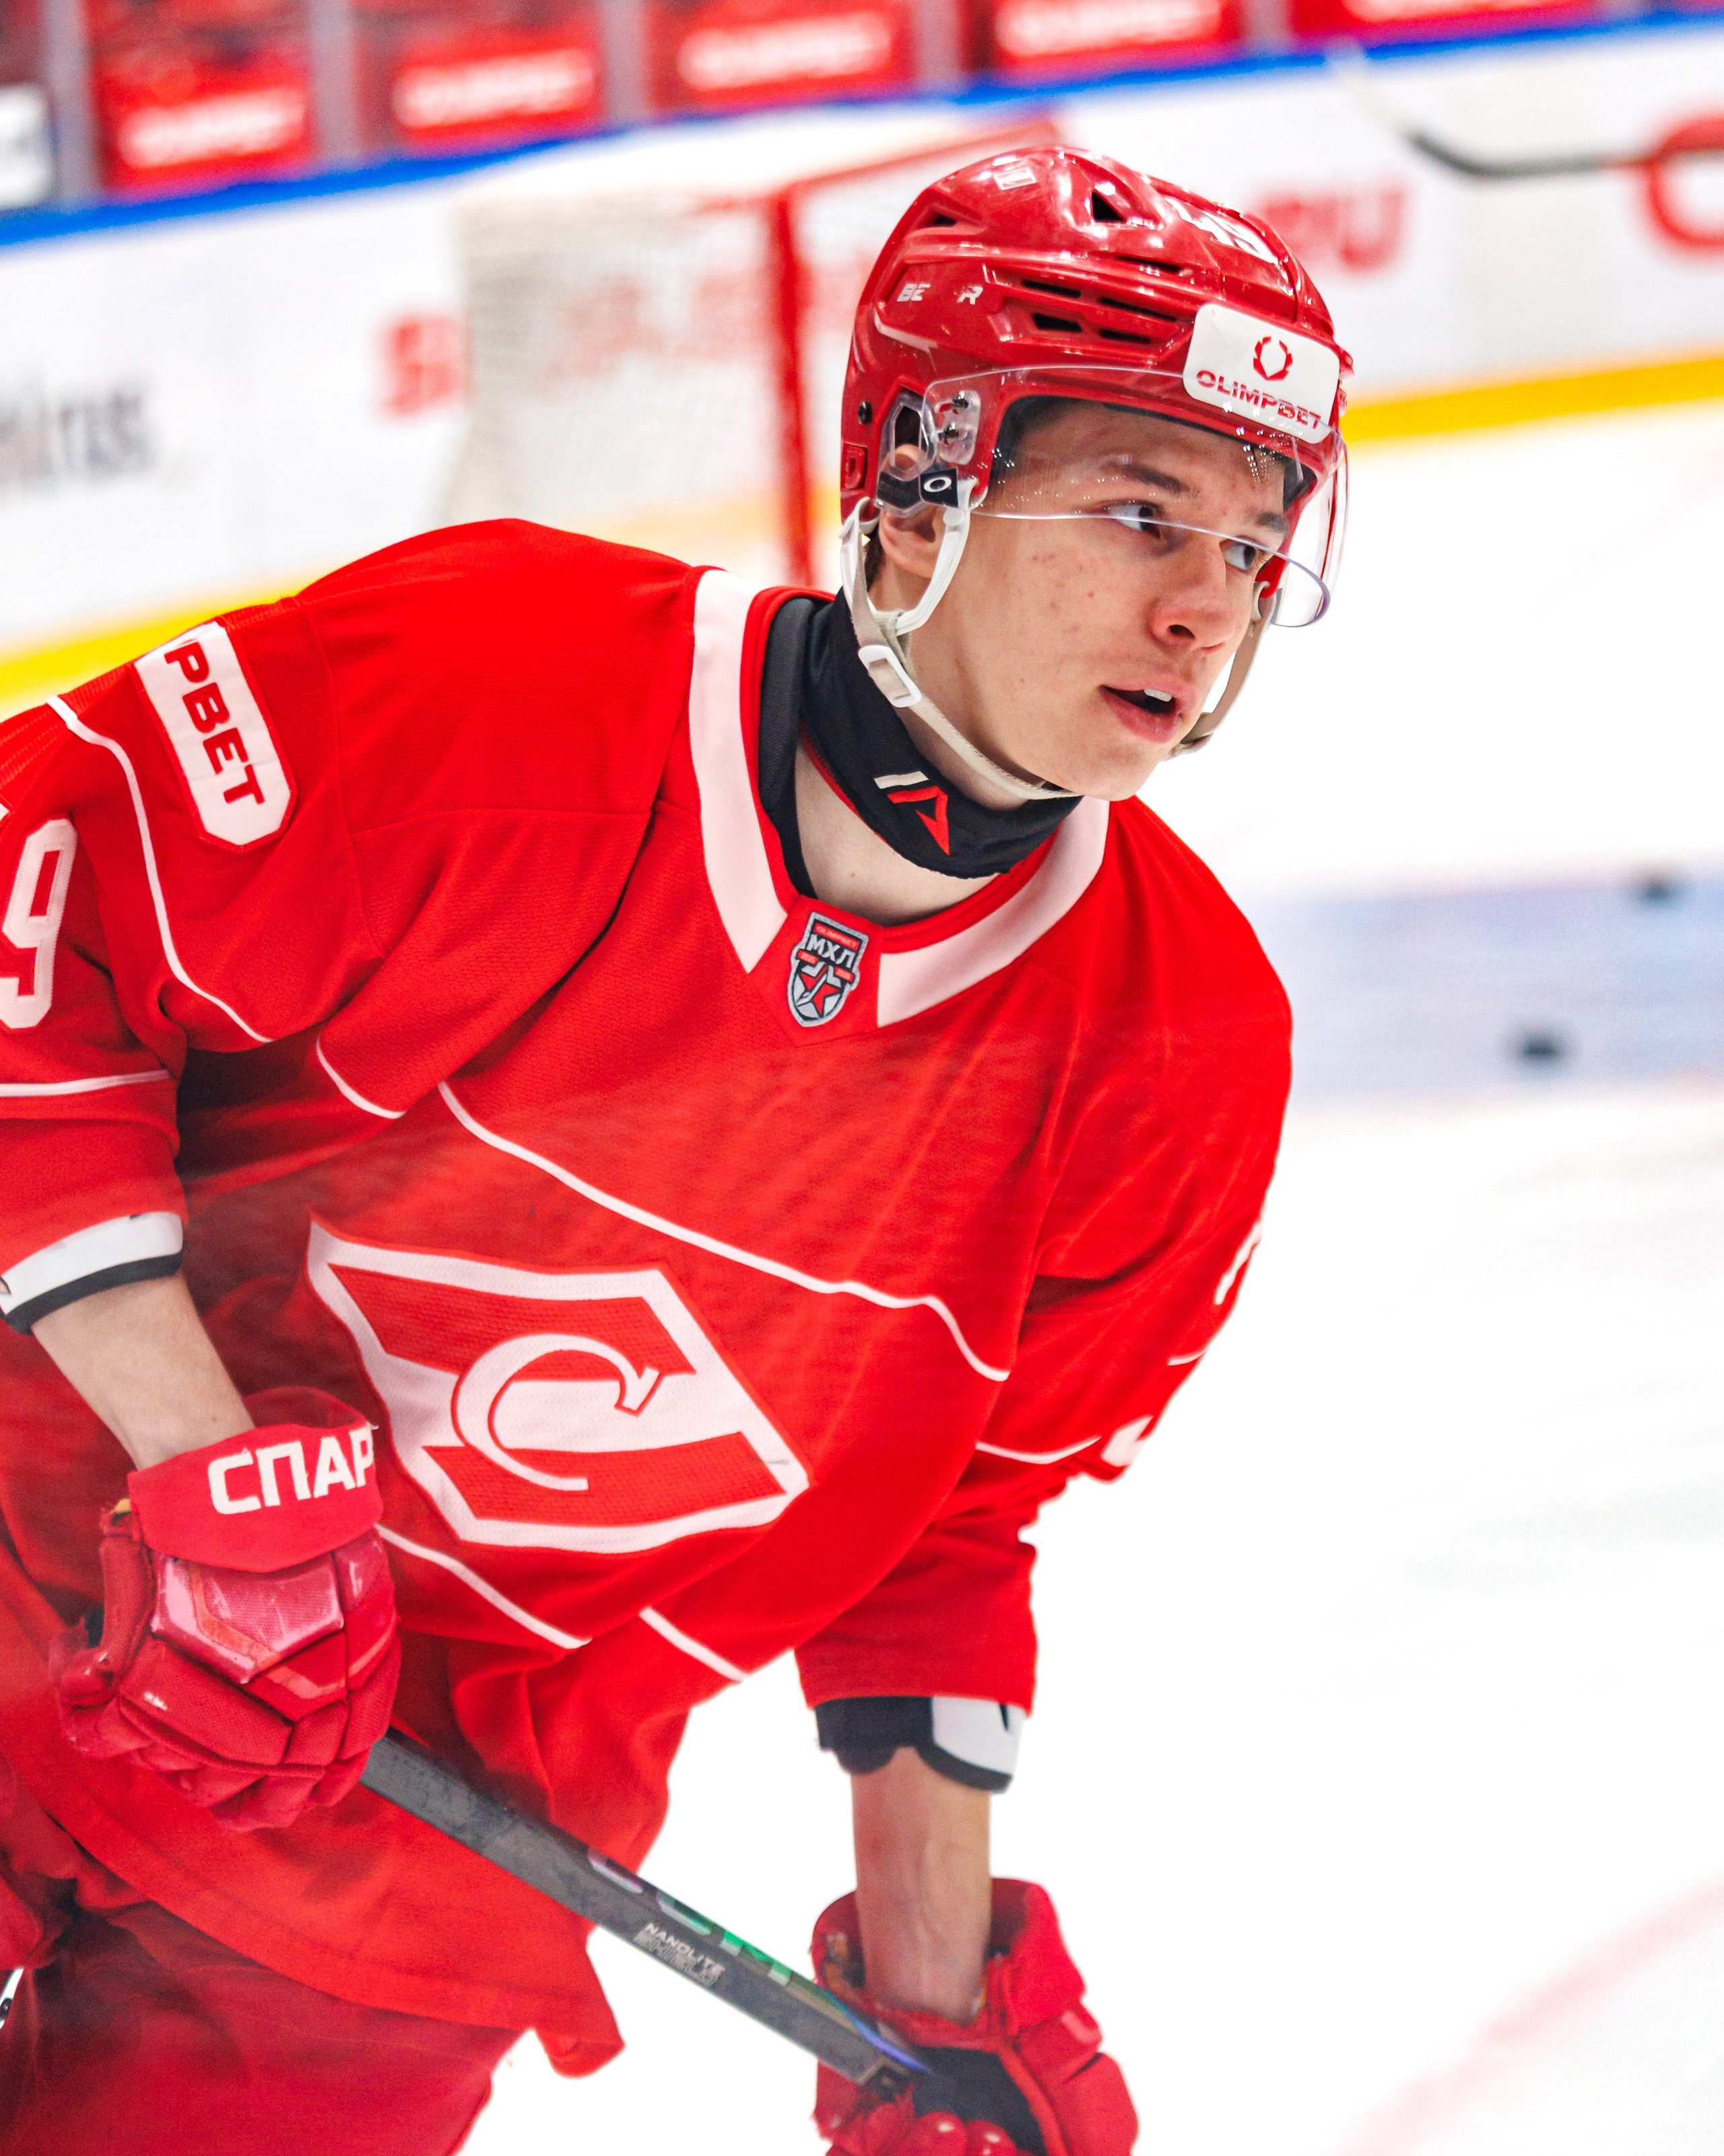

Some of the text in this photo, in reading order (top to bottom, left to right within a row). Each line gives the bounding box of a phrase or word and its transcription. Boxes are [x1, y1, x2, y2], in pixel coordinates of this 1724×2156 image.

[1195, 370, 1321, 430] OLIMPBET
[164, 641, 266, 805] PBET
[806, 934, 856, 968] МХЛ
[816, 925, 857, 948] OLIMPBET
[207, 1426, 374, 1515] СПАР
[644, 1922, 726, 1974] NANOLITE
